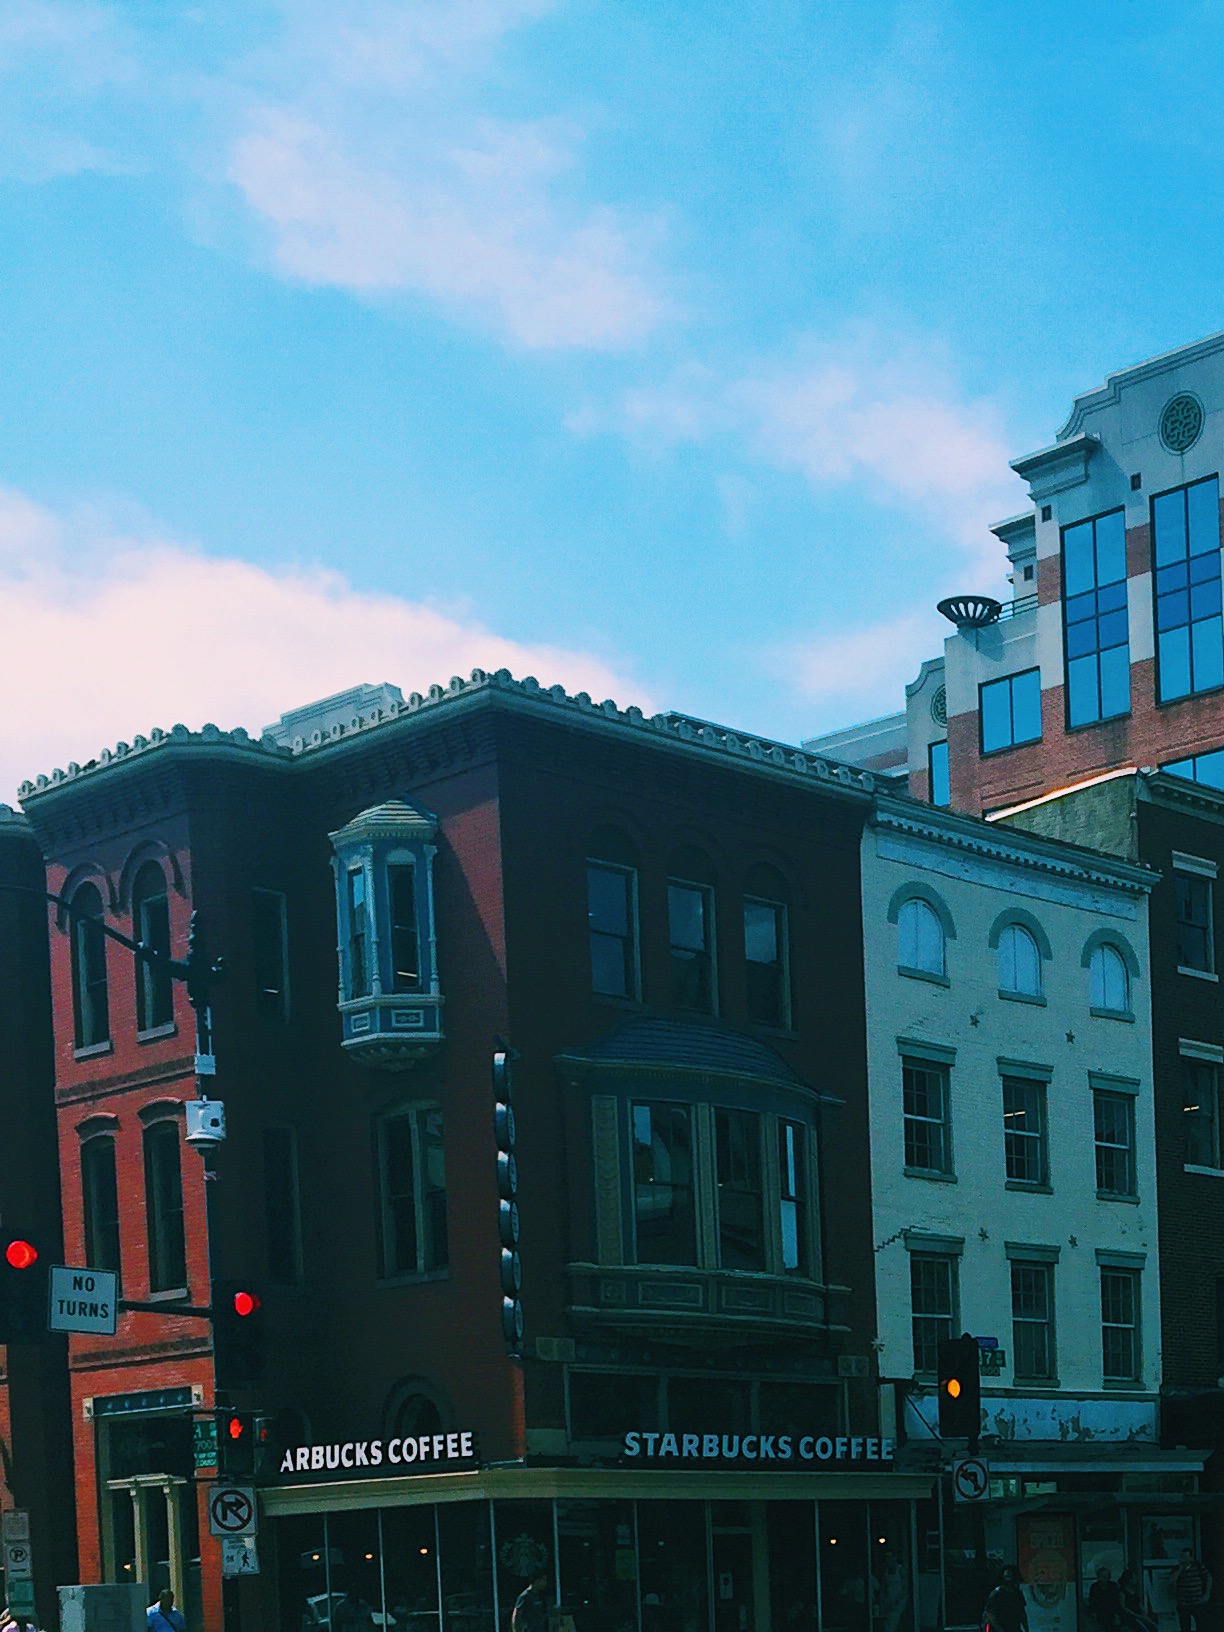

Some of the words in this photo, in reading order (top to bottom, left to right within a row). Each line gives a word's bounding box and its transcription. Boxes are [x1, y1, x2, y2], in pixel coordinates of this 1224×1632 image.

[73, 1275, 95, 1292] NO
[57, 1299, 109, 1319] TURNS
[280, 1440, 383, 1473] ARBUCKS
[388, 1432, 474, 1464] COFFEE
[624, 1431, 793, 1460] STARBUCKS
[799, 1435, 894, 1460] COFFEE
